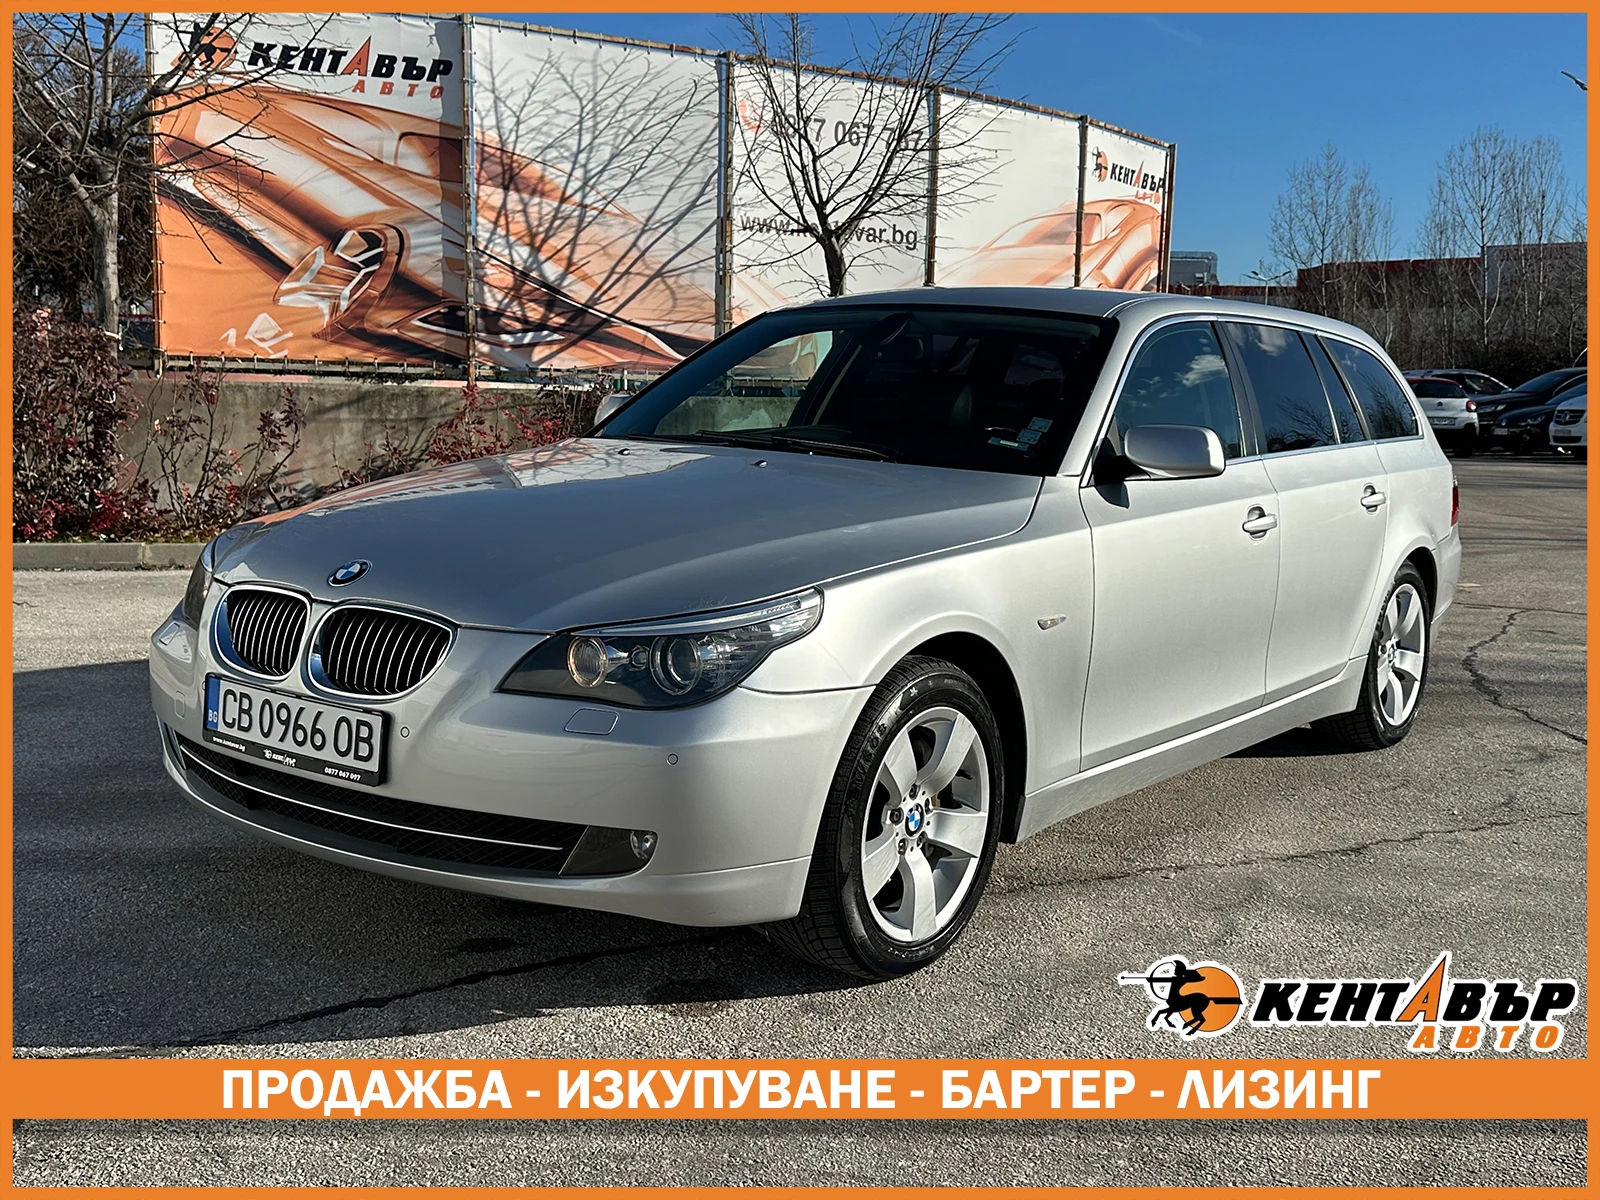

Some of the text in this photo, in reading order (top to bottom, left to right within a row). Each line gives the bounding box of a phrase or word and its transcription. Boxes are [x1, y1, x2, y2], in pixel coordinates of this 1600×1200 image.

[248, 35, 453, 82] КЕНТАВЪР
[352, 79, 444, 99] АВТО
[882, 126, 924, 151] 77
[1110, 160, 1165, 193] КЕНТАВЪР
[208, 709, 218, 723] BG
[259, 698, 326, 751] 0966
